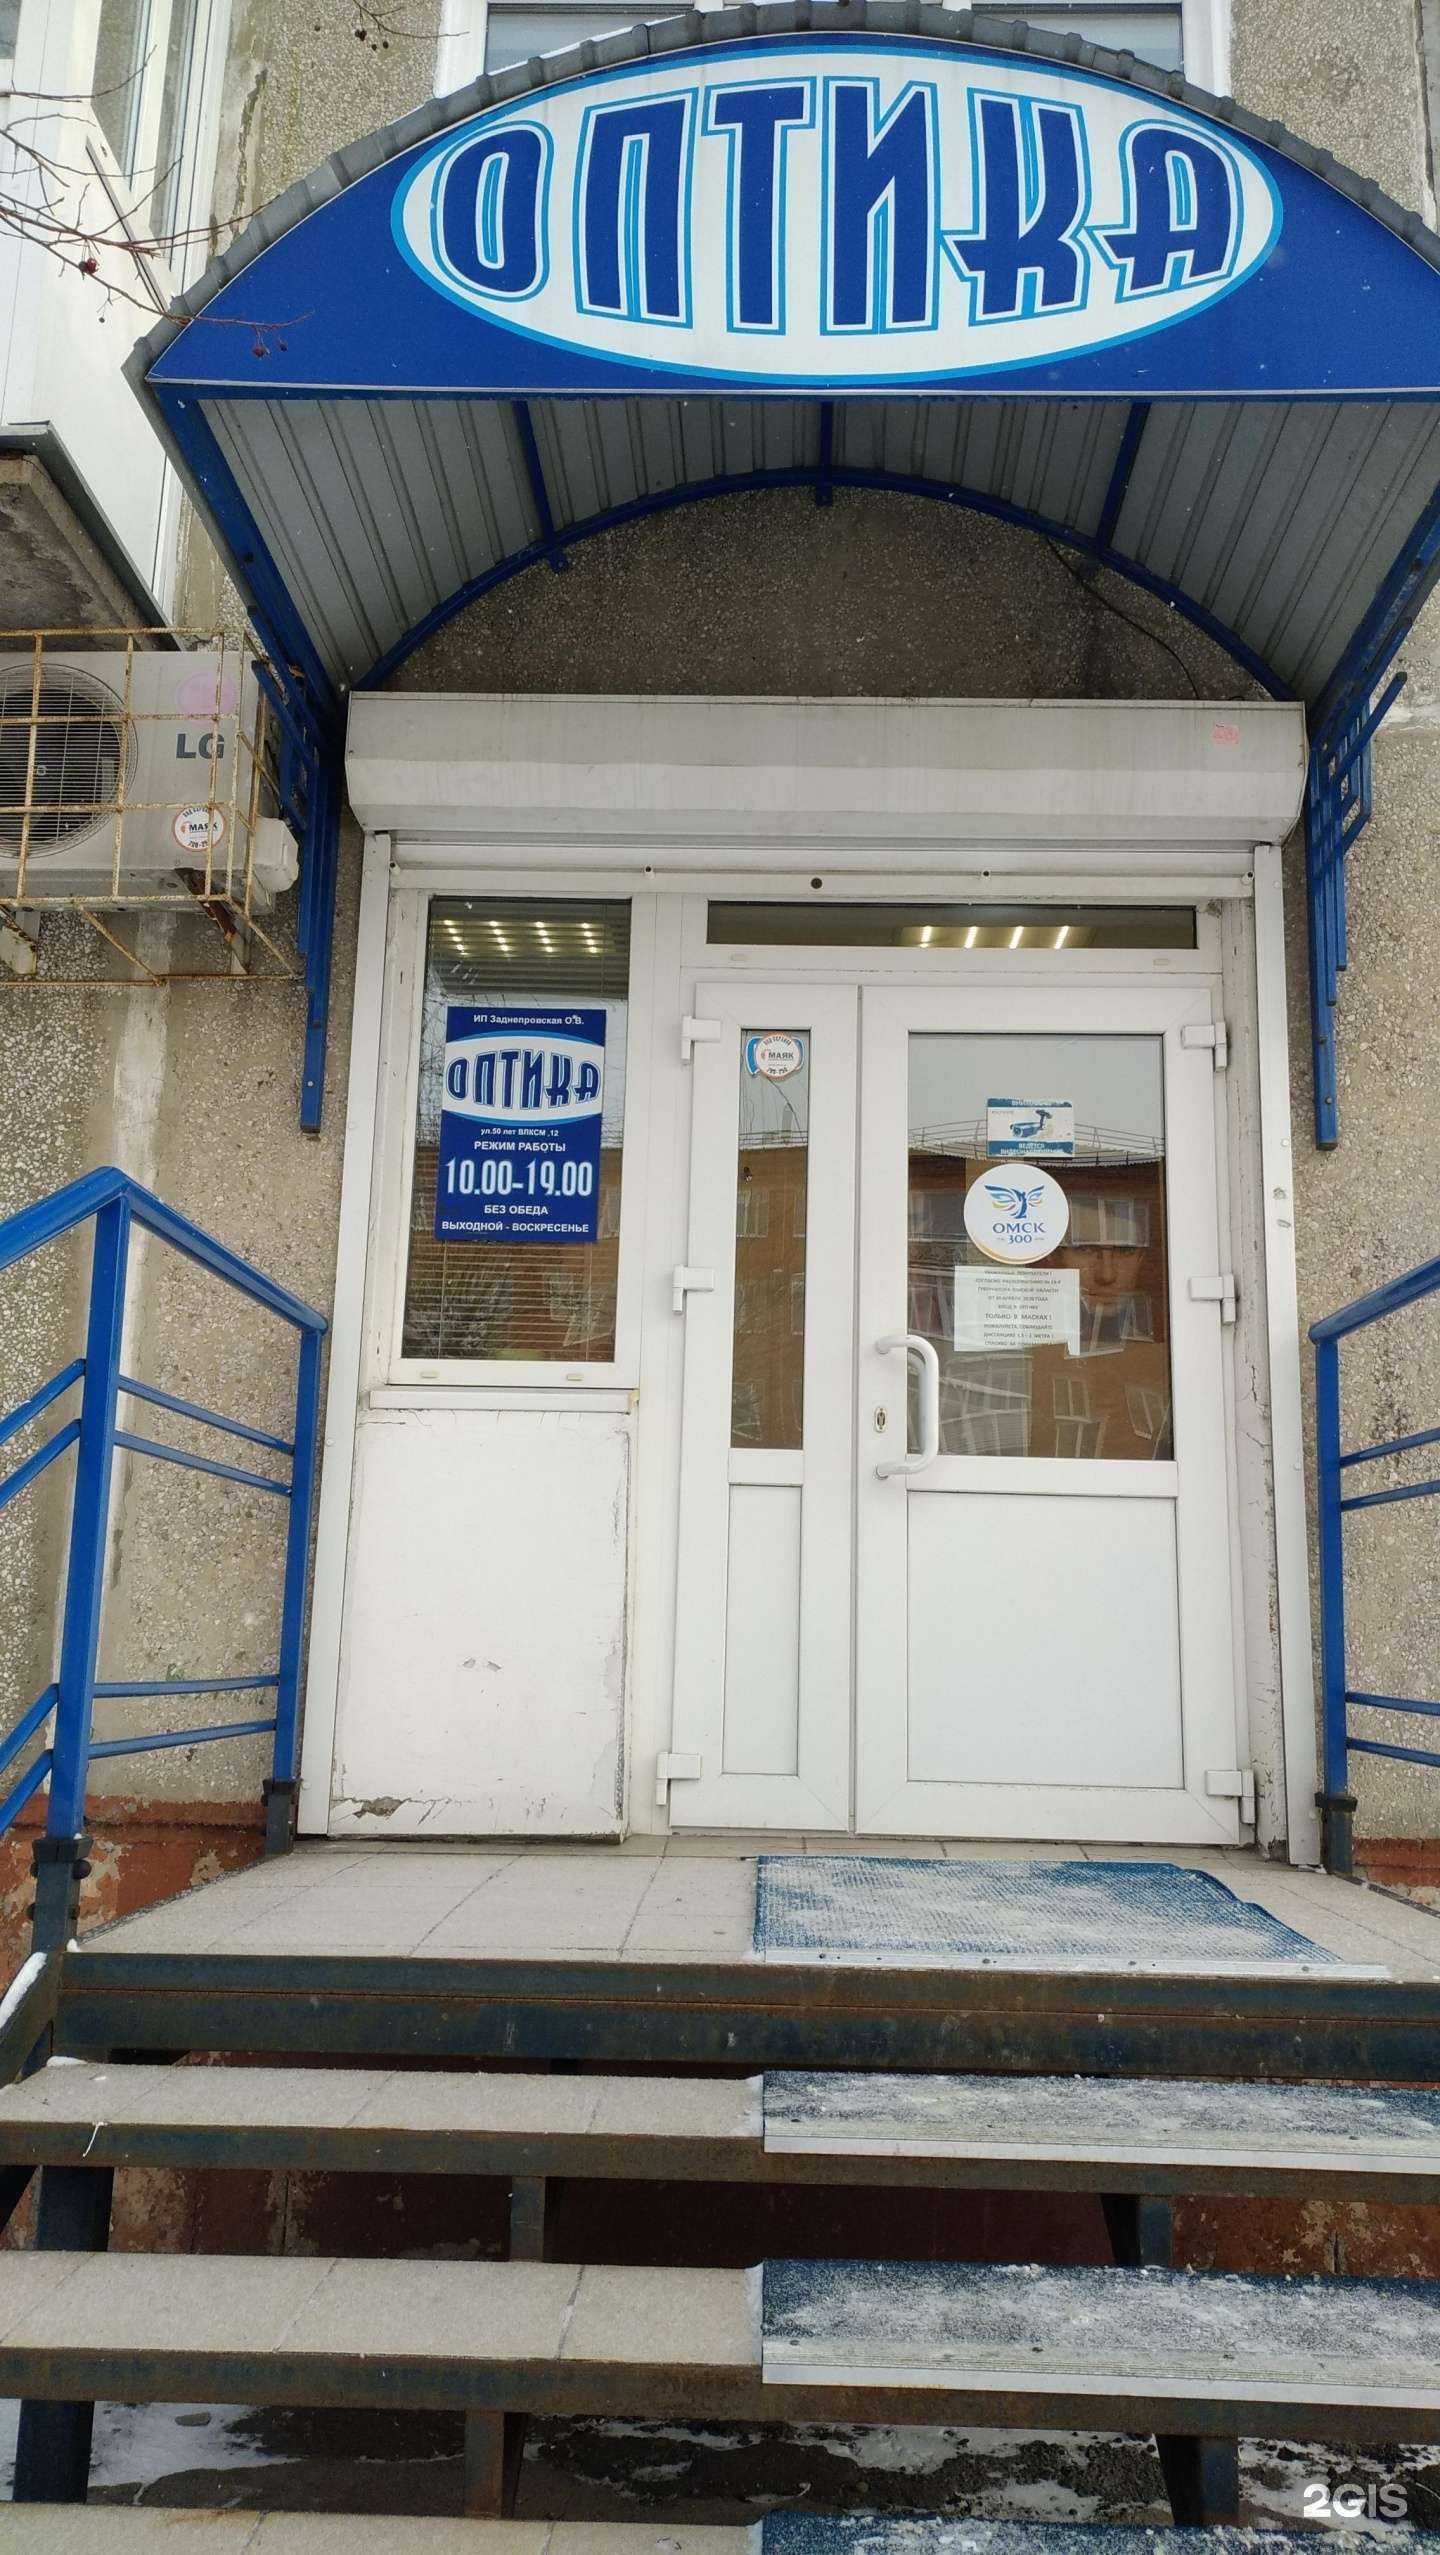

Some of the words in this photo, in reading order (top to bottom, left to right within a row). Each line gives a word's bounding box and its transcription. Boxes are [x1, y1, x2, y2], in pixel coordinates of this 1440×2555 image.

[431, 75, 1243, 336] ОПТИКА
[176, 733, 225, 759] LG
[473, 1014, 488, 1023] ИП
[490, 1014, 562, 1026] Заднепровская
[768, 1052, 794, 1060] МАЯК
[447, 1049, 601, 1110] ОПТИКА
[518, 1128, 546, 1137] ВЛКСМ
[474, 1140, 516, 1151] РЕЖИМ
[518, 1141, 566, 1152] РАБОТЫ
[445, 1157, 593, 1197] 10.00-19.00
[484, 1204, 506, 1215] БЕЗ
[509, 1205, 549, 1216] ОБЕДА
[442, 1220, 503, 1232] ВЫХОДНОЙ
[512, 1222, 590, 1233] ВОСКРЕСЕНЬЕ
[992, 1222, 1047, 1234] ОМСК
[1007, 1234, 1033, 1245] 300
